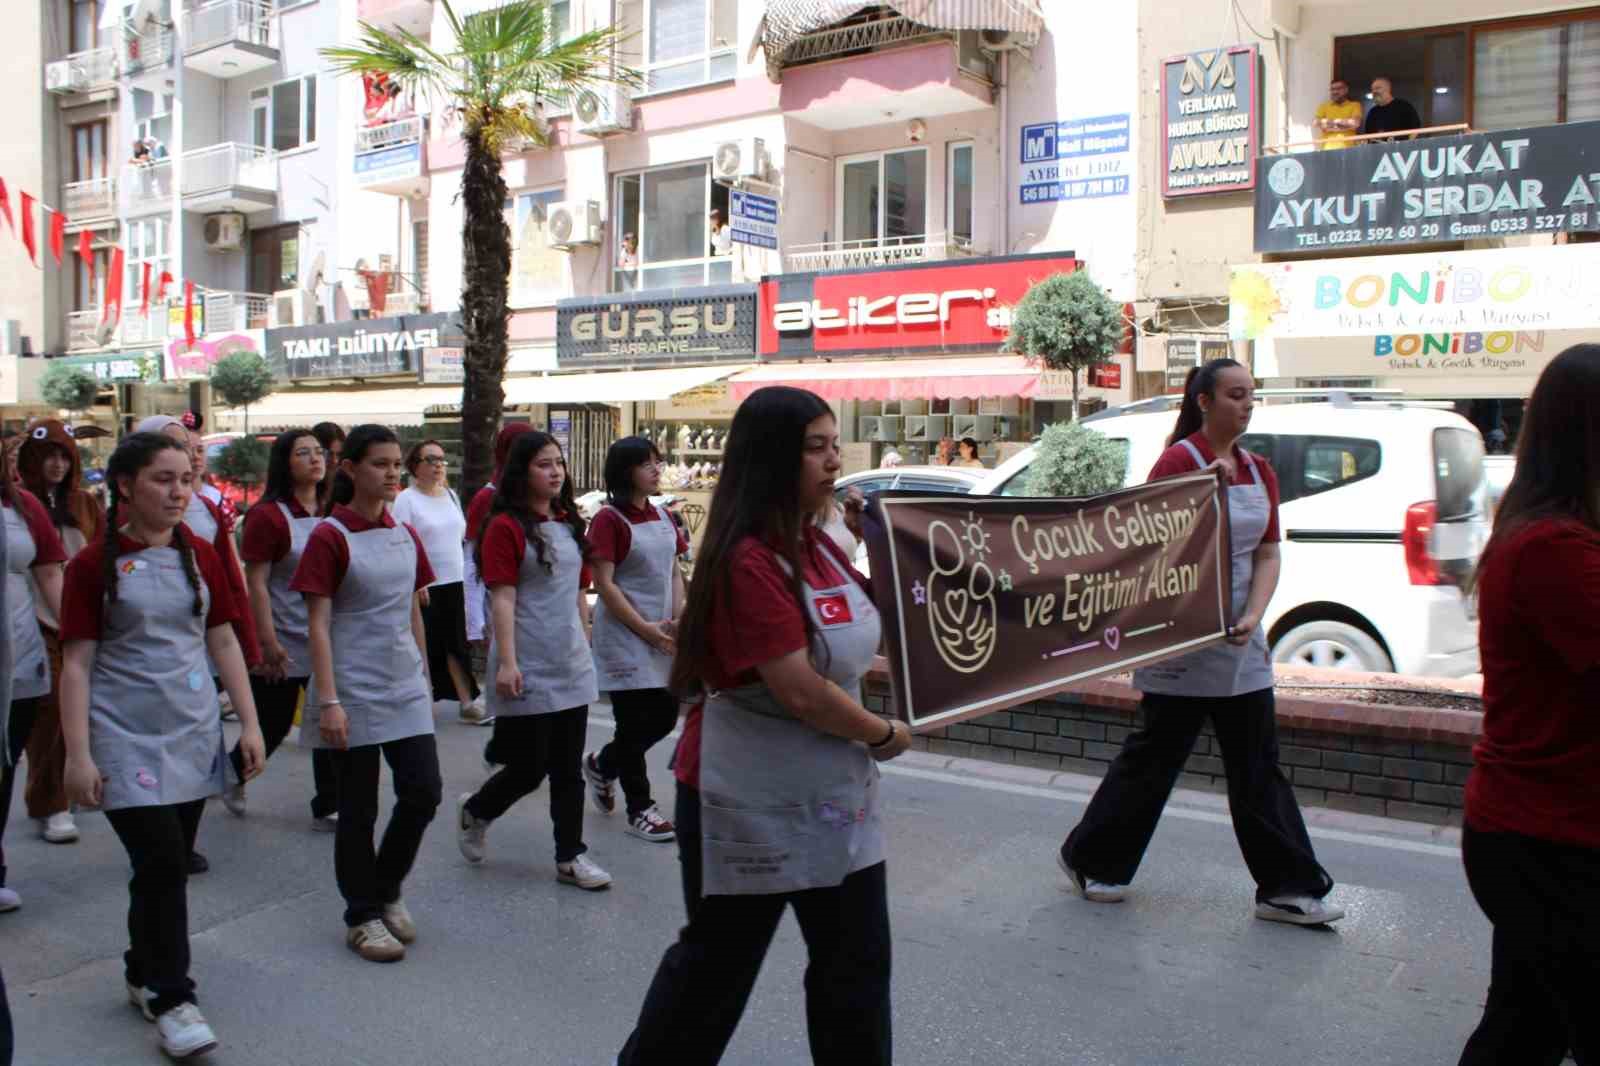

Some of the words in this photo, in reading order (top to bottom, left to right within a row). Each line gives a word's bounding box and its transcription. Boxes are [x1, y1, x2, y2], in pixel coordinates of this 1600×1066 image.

[1168, 120, 1204, 138] HUKUK
[1205, 112, 1249, 134] BÜROSU
[1169, 137, 1248, 171] AVUKAT
[1370, 138, 1530, 184] AVUKAT
[1267, 191, 1386, 230] AYKUT
[1403, 178, 1546, 220] SERDAR
[1328, 229, 1361, 244] 0232
[1367, 226, 1393, 241] 592
[1398, 225, 1417, 238] 60
[1421, 223, 1440, 237] 20
[1490, 217, 1529, 232] 0533
[1535, 214, 1567, 229] 527
[1570, 212, 1588, 226] 81
[570, 303, 735, 341] GÜRSU
[1011, 508, 1104, 575] Çocuk
[1104, 497, 1197, 552] Gelişimi
[1023, 593, 1056, 629] ve
[1062, 565, 1145, 632] Eğitimi
[1145, 556, 1199, 602] Alanı
